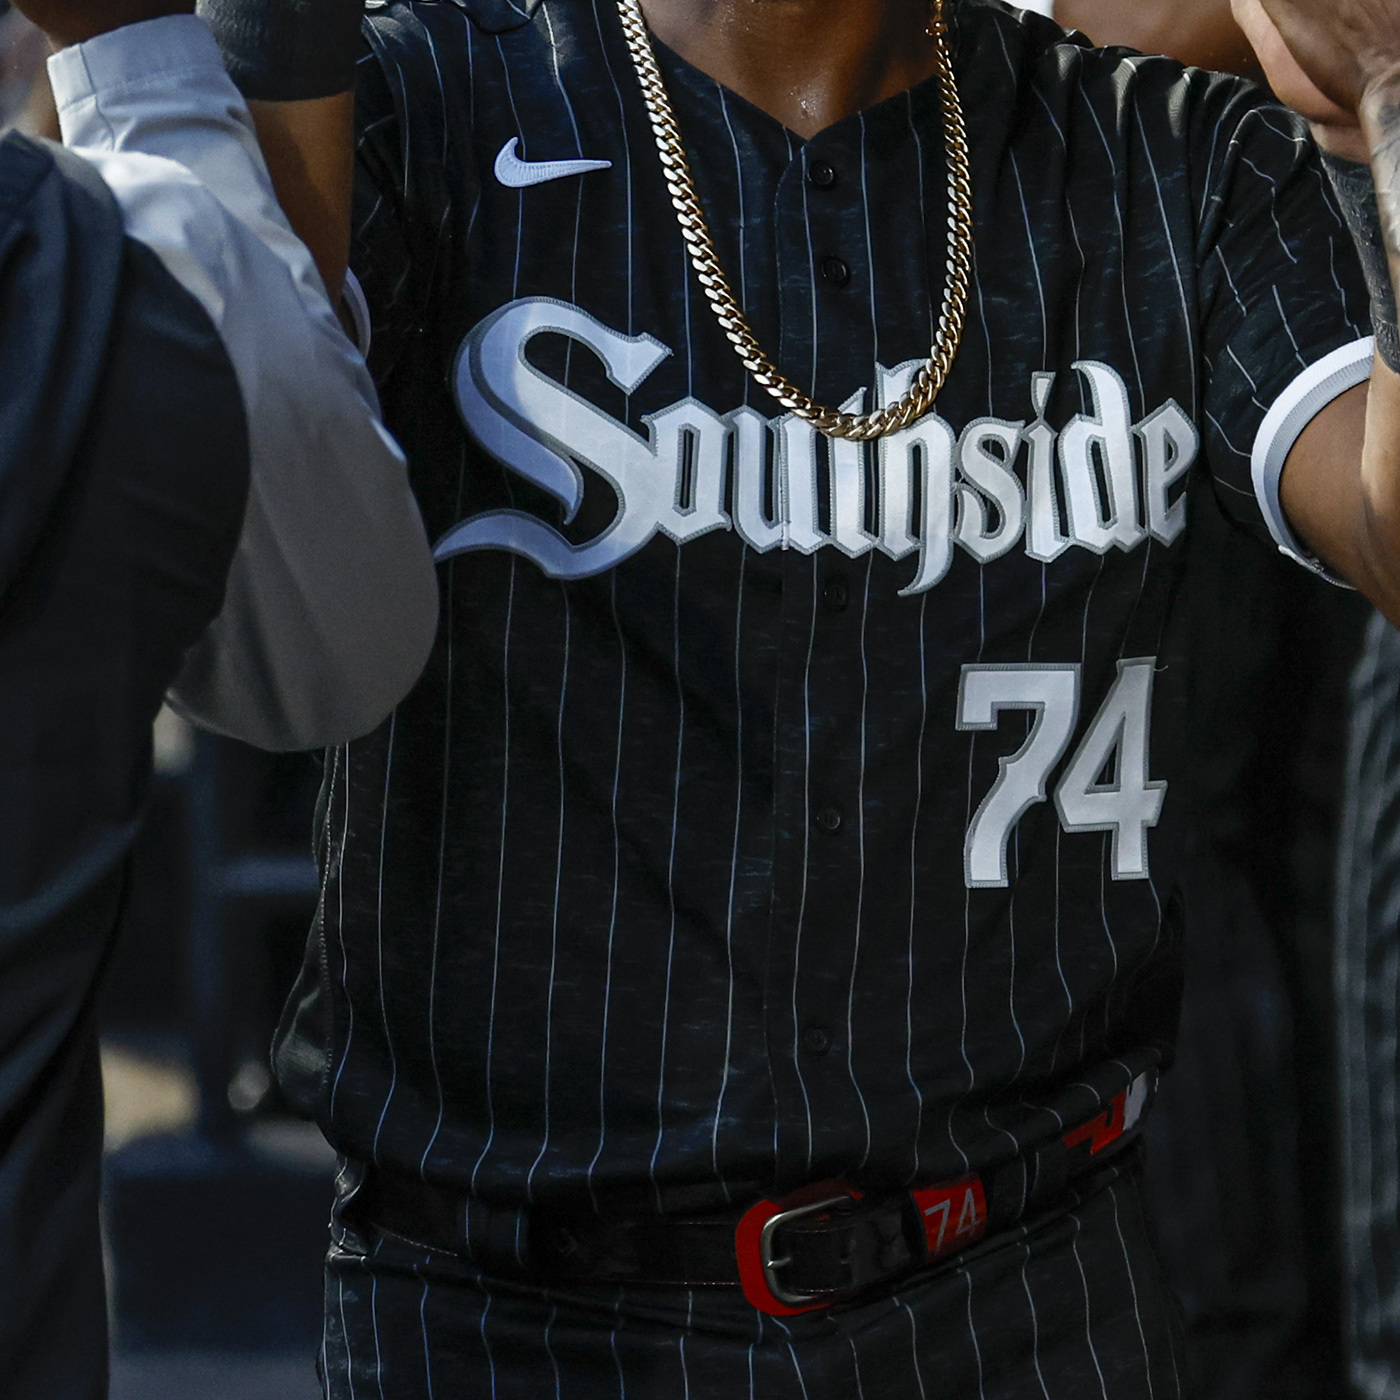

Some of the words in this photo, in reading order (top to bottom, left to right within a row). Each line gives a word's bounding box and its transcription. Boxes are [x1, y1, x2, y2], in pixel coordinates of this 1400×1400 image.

[432, 295, 1201, 596] Southside
[954, 655, 1169, 889] 74
[923, 1186, 982, 1255] 74
